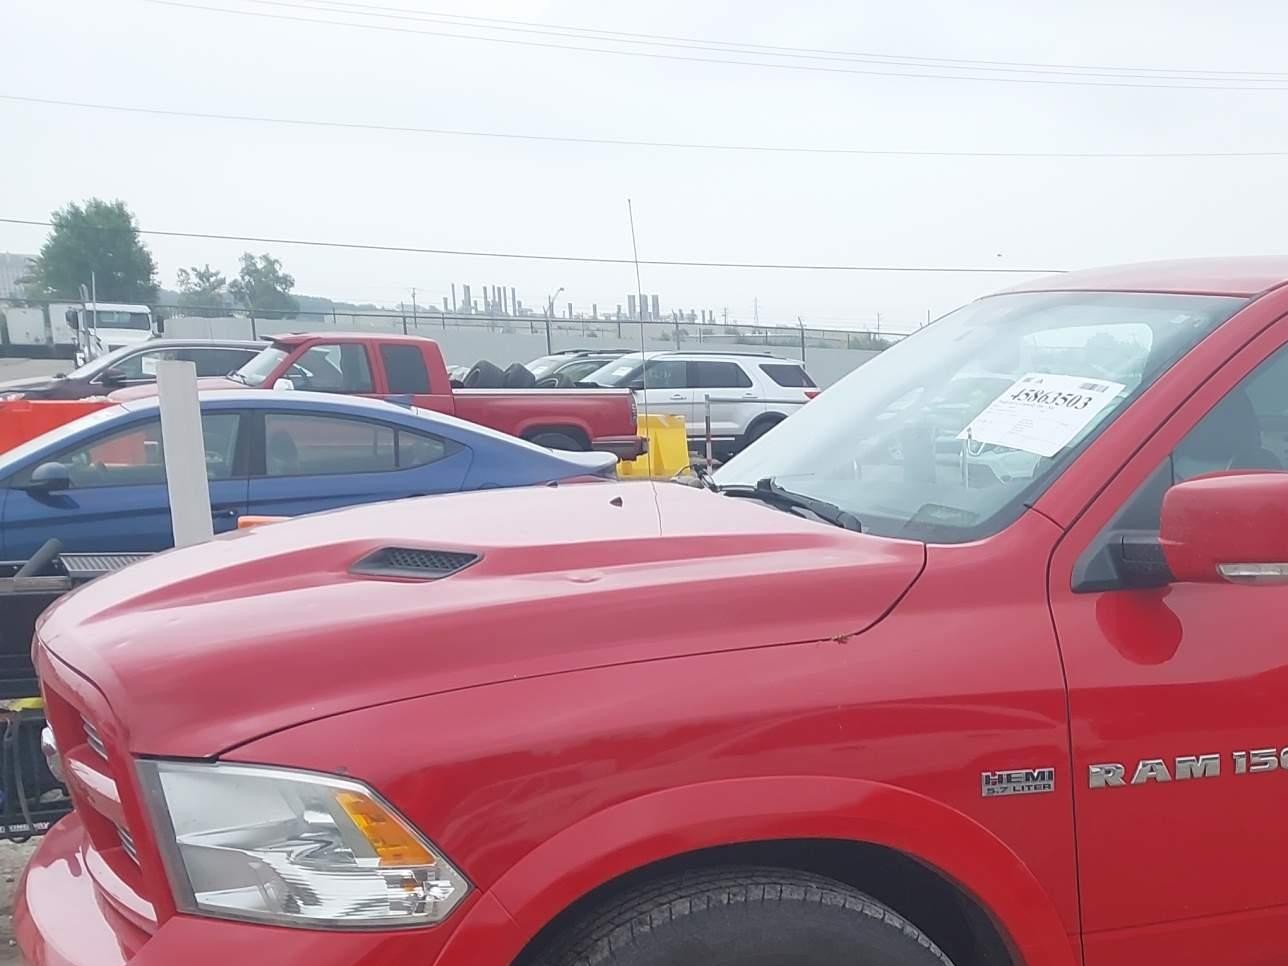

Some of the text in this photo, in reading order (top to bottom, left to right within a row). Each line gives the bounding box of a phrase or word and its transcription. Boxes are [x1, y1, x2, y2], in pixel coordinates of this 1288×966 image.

[1010, 388, 1093, 410] 45863503
[984, 769, 1054, 786] HEMI
[1088, 753, 1221, 789] RAM
[986, 783, 1052, 795] 5.7 LITER
